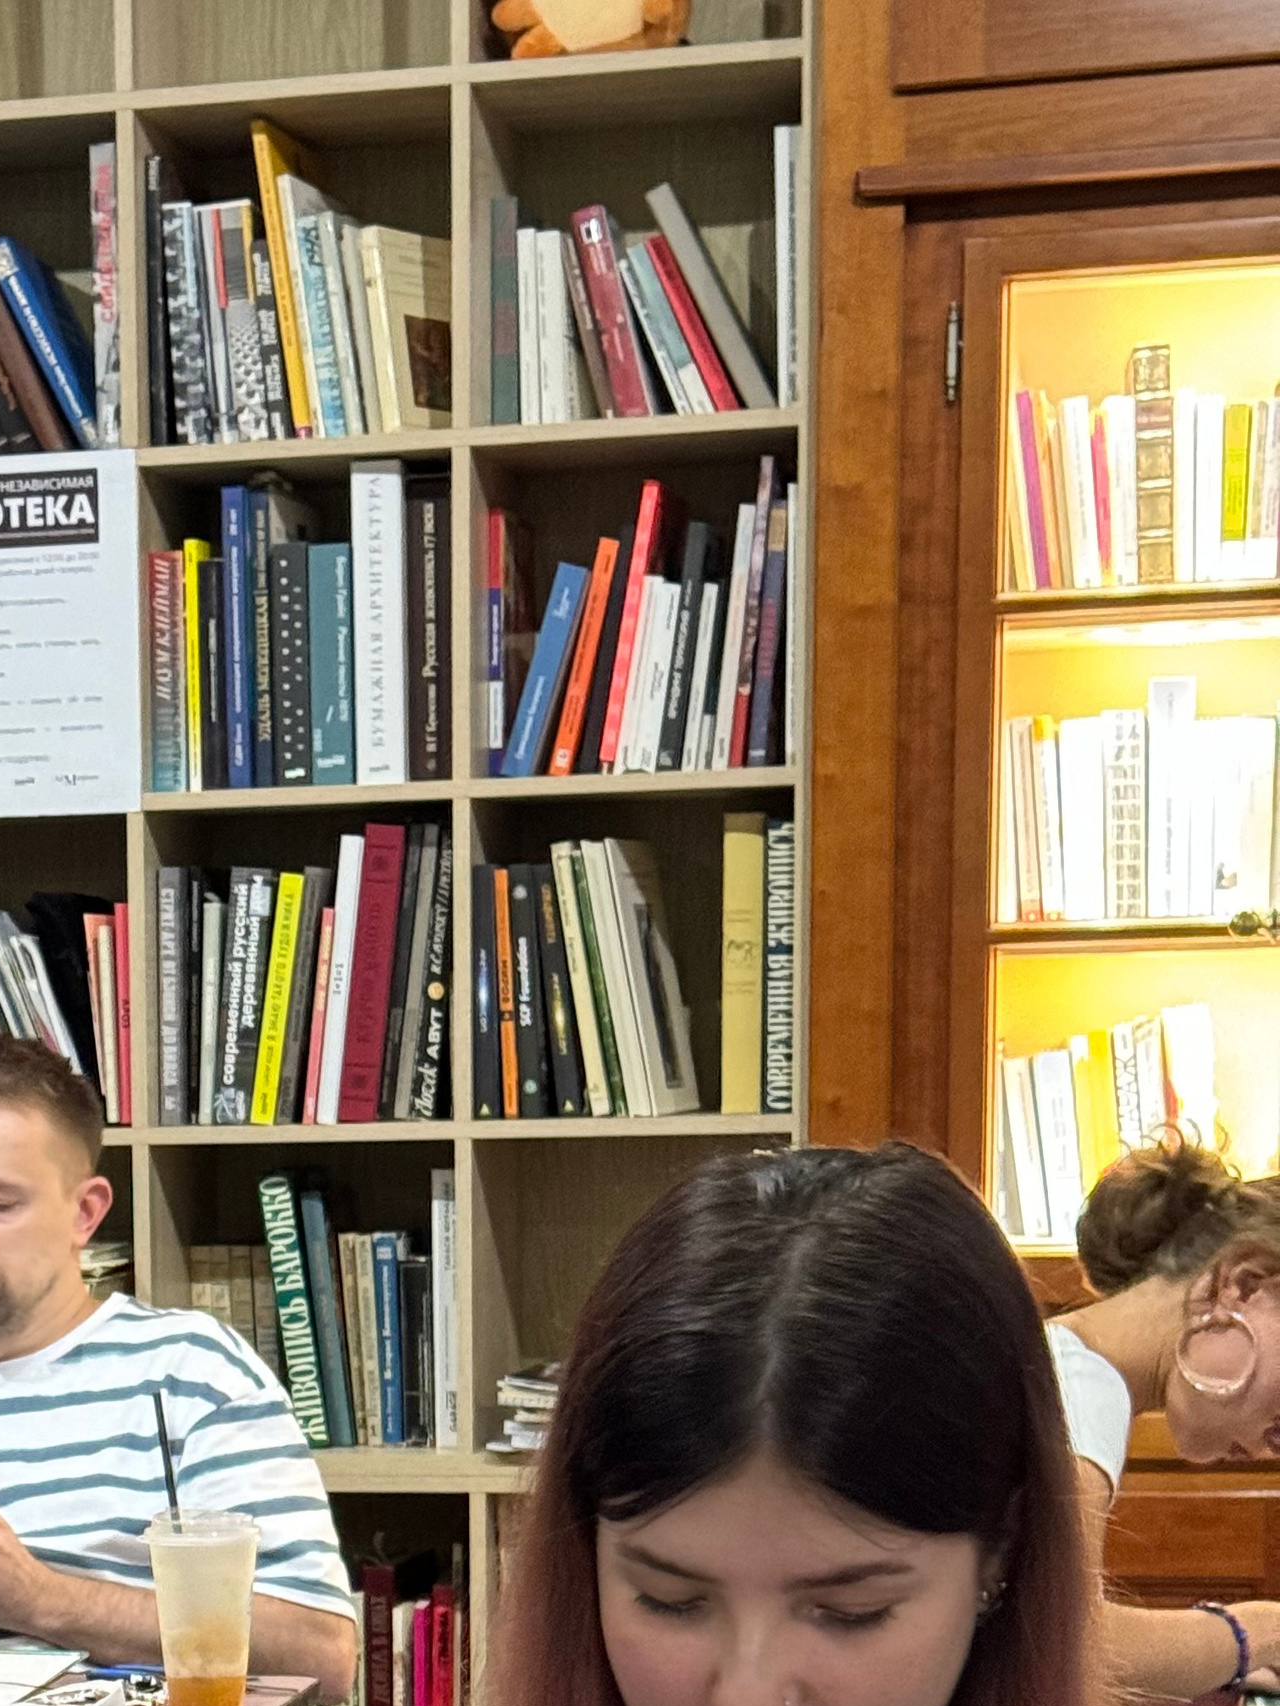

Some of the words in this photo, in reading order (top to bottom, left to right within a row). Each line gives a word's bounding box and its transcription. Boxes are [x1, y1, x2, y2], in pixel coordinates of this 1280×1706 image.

[0, 476, 94, 493] НЕЗАВИСИМАЯ
[369, 476, 383, 623] АРХИТЕКТУРА
[370, 632, 384, 746] БУМАЖНАЯ
[228, 883, 251, 957] русский
[237, 916, 263, 1028] деревянный
[217, 960, 246, 1085] современный
[765, 953, 793, 1109] СОВРЕМЕННАЯ
[259, 1175, 305, 1292] БАРОККО
[278, 1297, 328, 1441] ЖИВОПИСЬ
